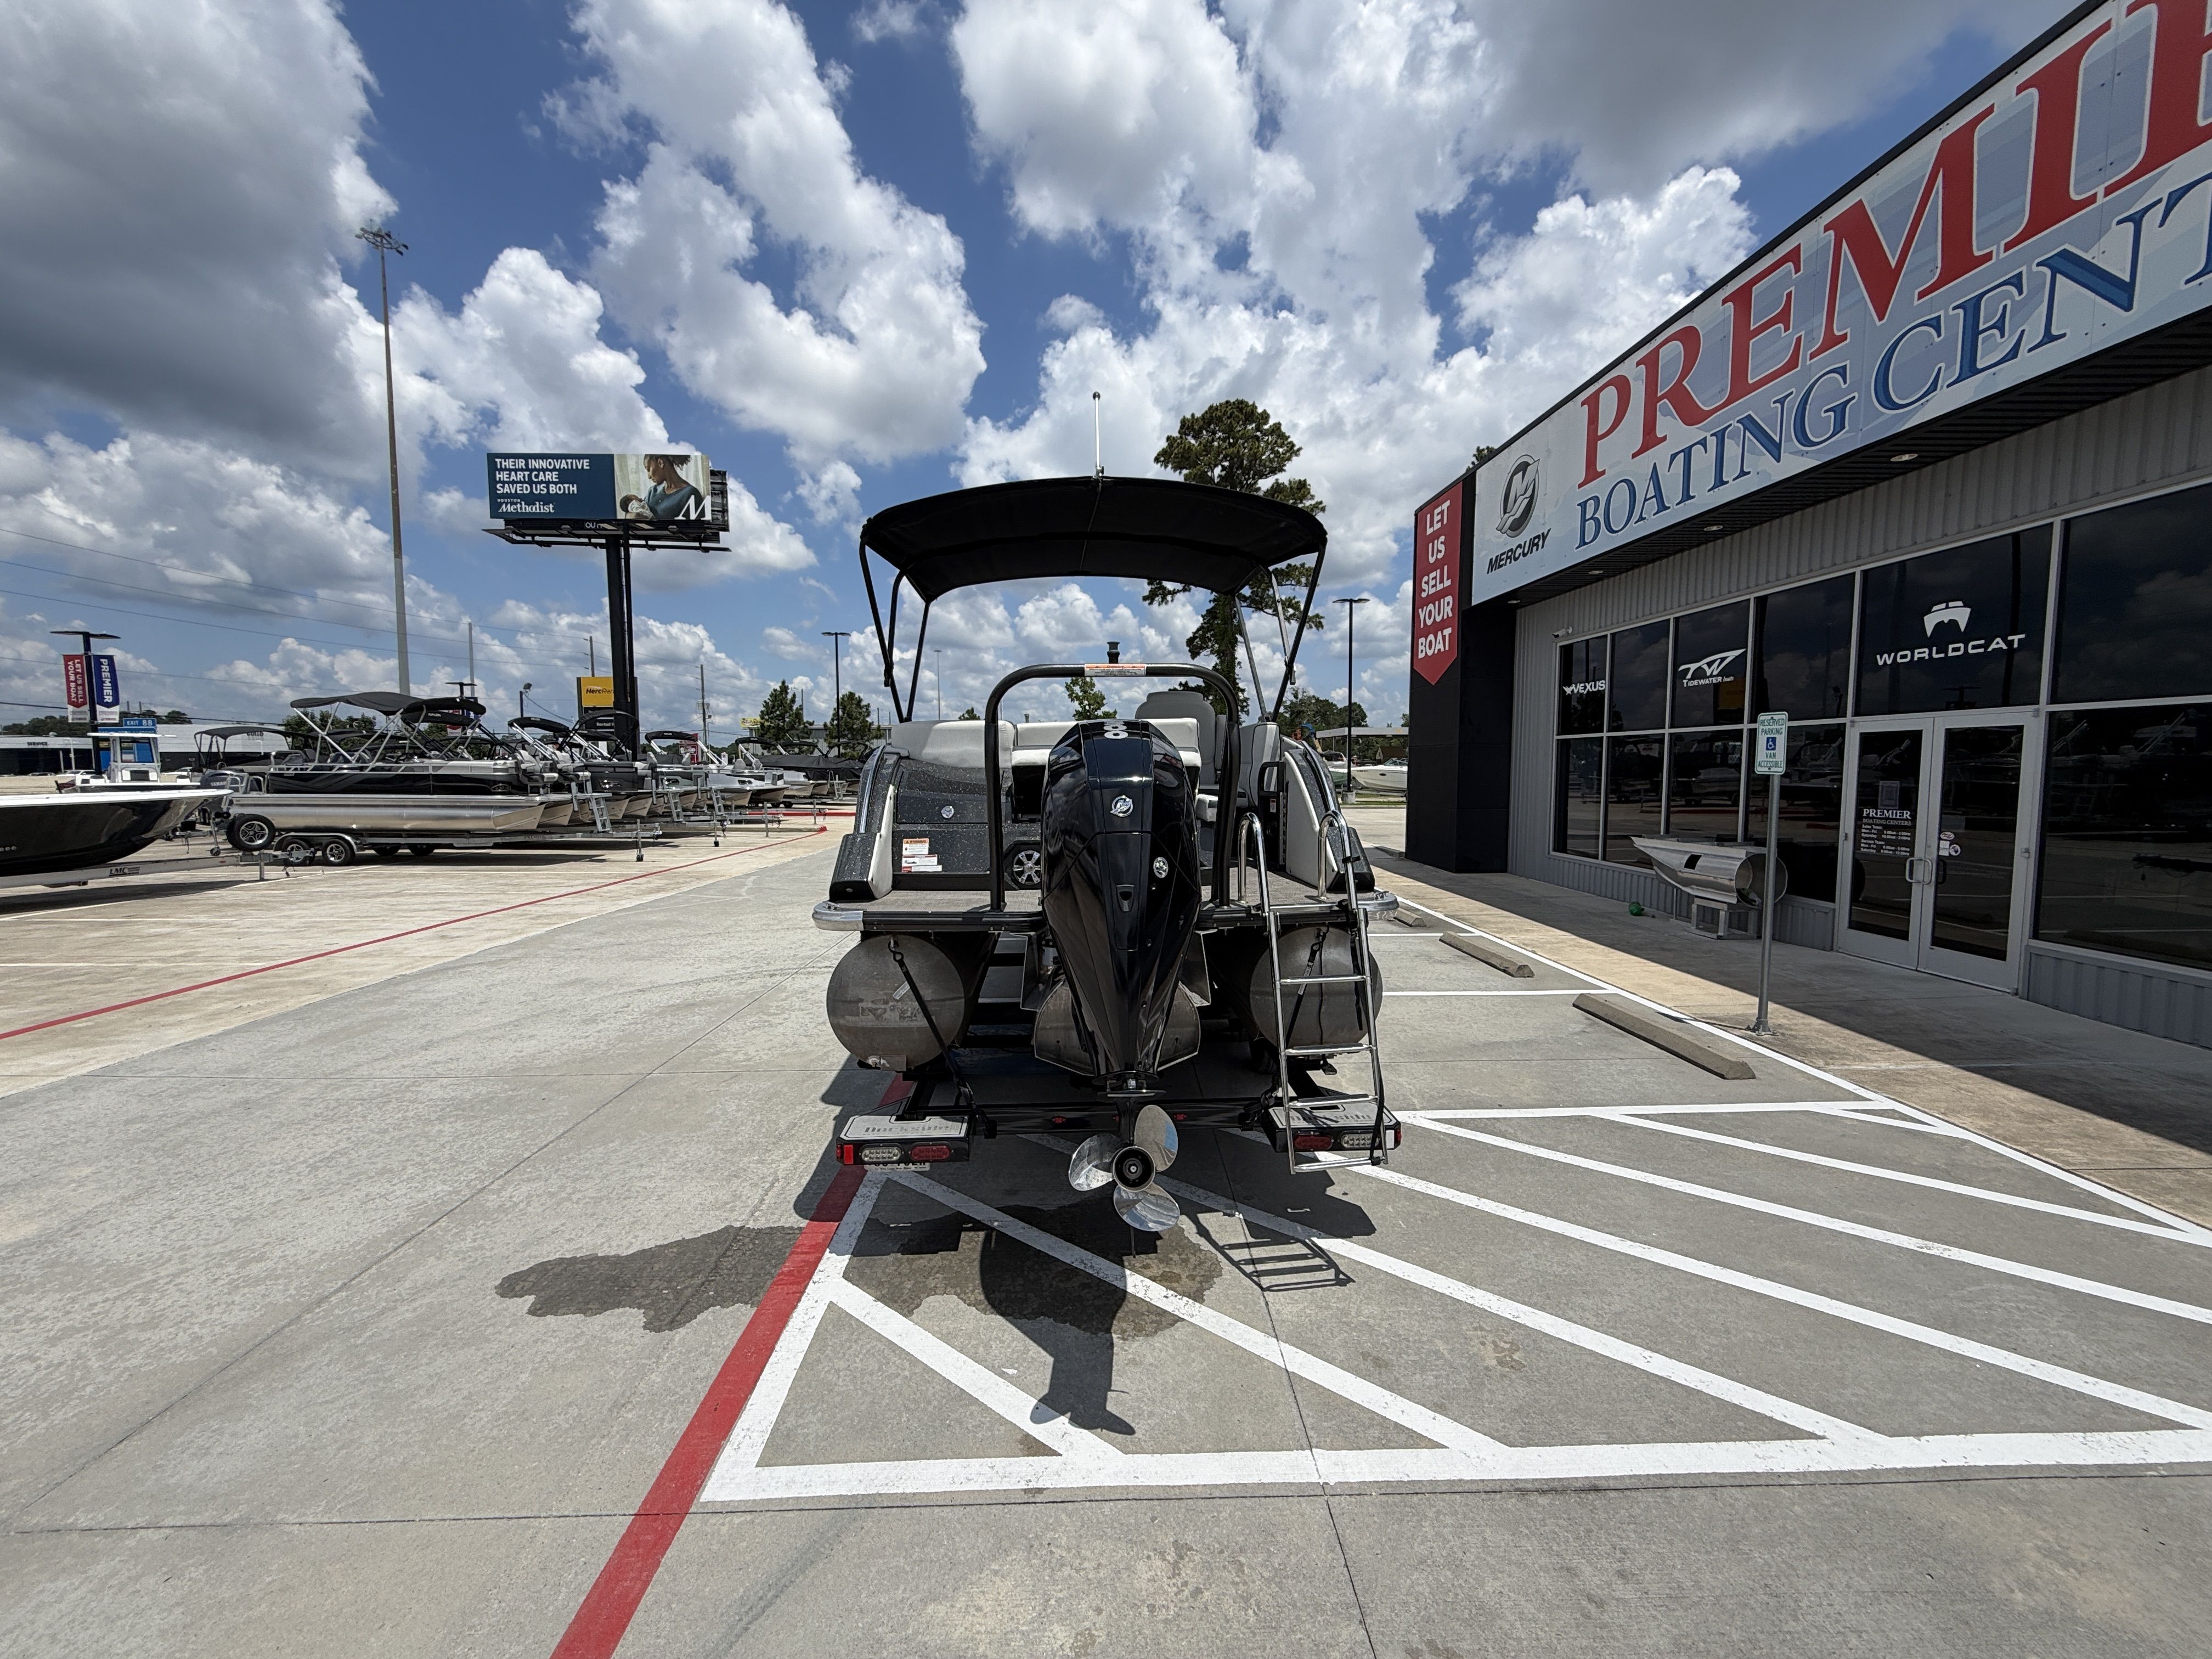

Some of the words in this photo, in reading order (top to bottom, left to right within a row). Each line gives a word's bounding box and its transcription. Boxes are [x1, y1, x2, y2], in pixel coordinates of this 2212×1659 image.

[495, 459, 526, 469] THEIR
[529, 459, 590, 469] INNOVATIVE
[1575, 364, 1857, 550] BOATING
[496, 471, 530, 481] HEART
[532, 471, 559, 482] CARE
[496, 484, 530, 494] SAVED
[533, 484, 547, 494] US
[549, 484, 577, 494] BOTH
[498, 501, 555, 513] Methodist
[1426, 500, 1450, 536] LET
[1429, 536, 1446, 563] US
[1486, 528, 1551, 575] MERCURY
[1421, 565, 1451, 598] SELL
[1418, 595, 1453, 629] YOUR
[1418, 627, 1452, 659] BOAT
[1876, 634, 2025, 665] WORLDCAT
[76, 675, 82, 684] US
[100, 659, 112, 702] PREMIER
[1572, 680, 1606, 694] VEXUS
[1760, 718, 1784, 727] RESERVED
[1863, 809, 1912, 819] PREMIER
